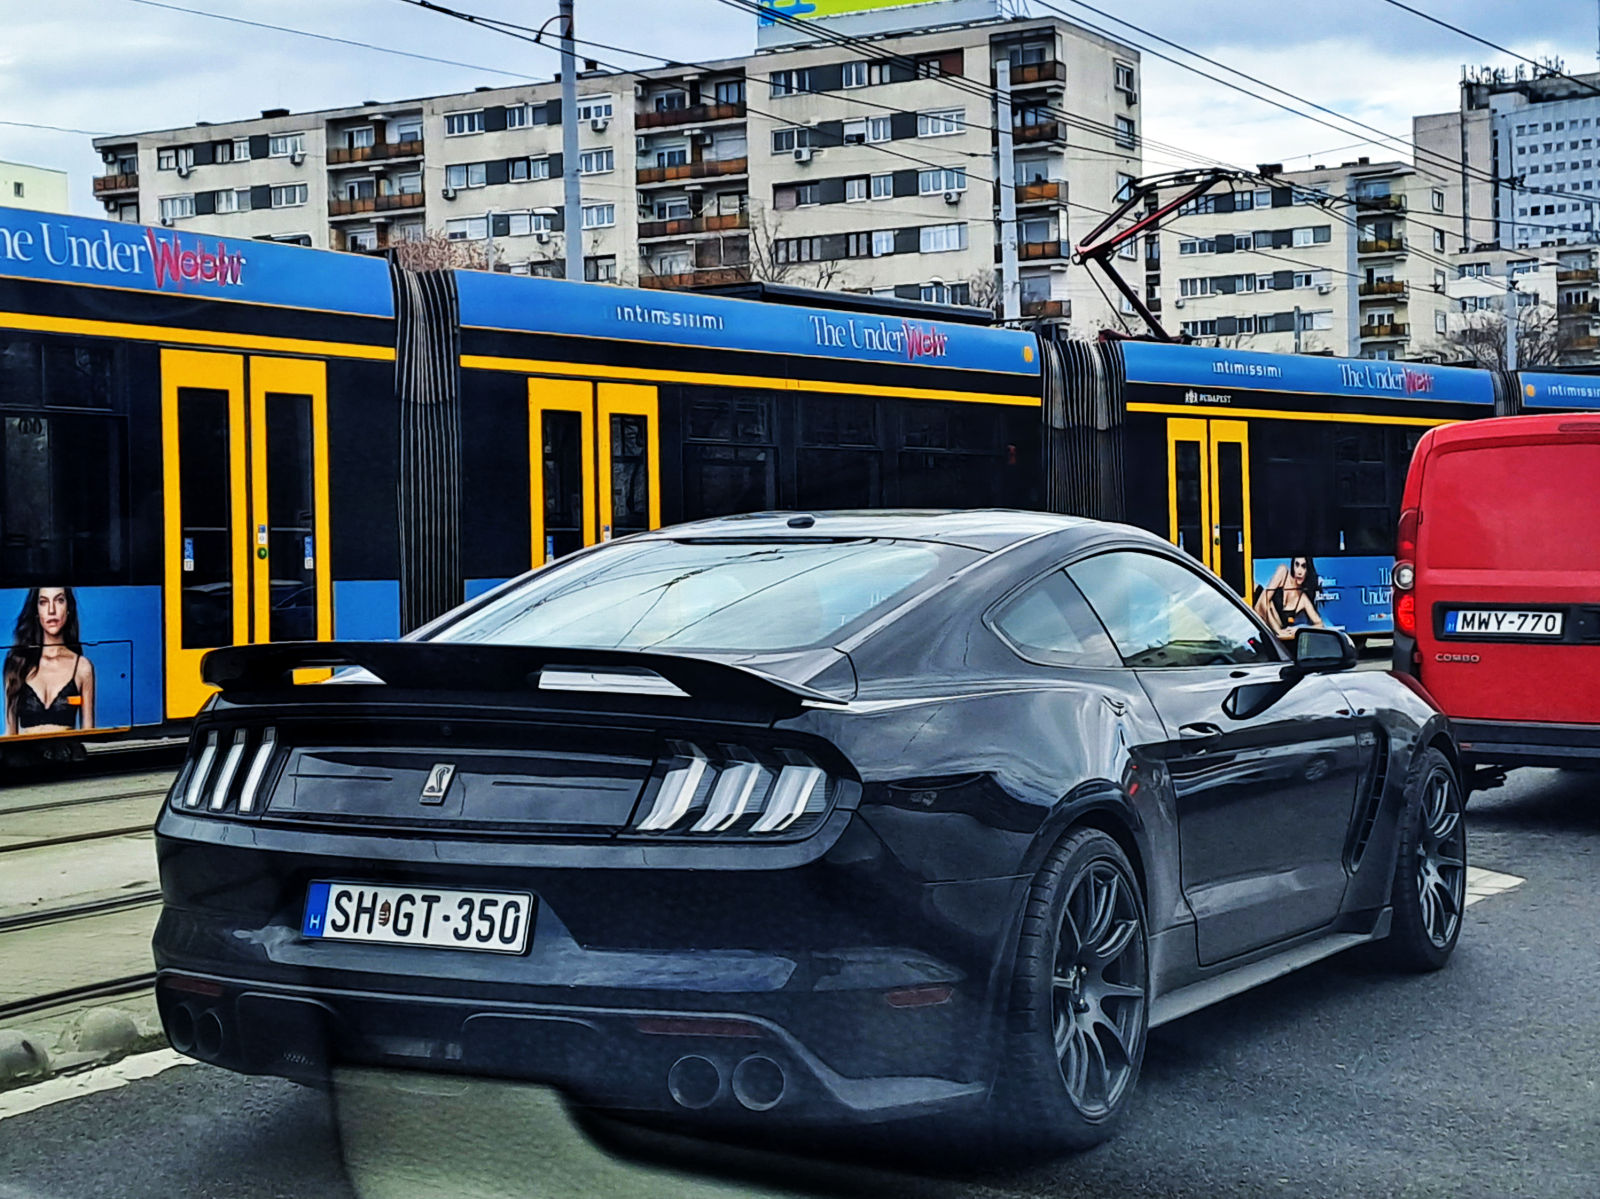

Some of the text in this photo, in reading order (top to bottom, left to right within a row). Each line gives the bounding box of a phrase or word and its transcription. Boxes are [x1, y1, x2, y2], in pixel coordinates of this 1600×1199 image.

[809, 315, 846, 347] The
[1212, 360, 1283, 378] intimissimi
[1337, 363, 1364, 388] The
[1547, 384, 1600, 398] intimissi
[1378, 567, 1393, 585] Th
[1461, 612, 1557, 632] MWY-770
[1435, 653, 1480, 662] COMBO
[309, 914, 321, 929] H
